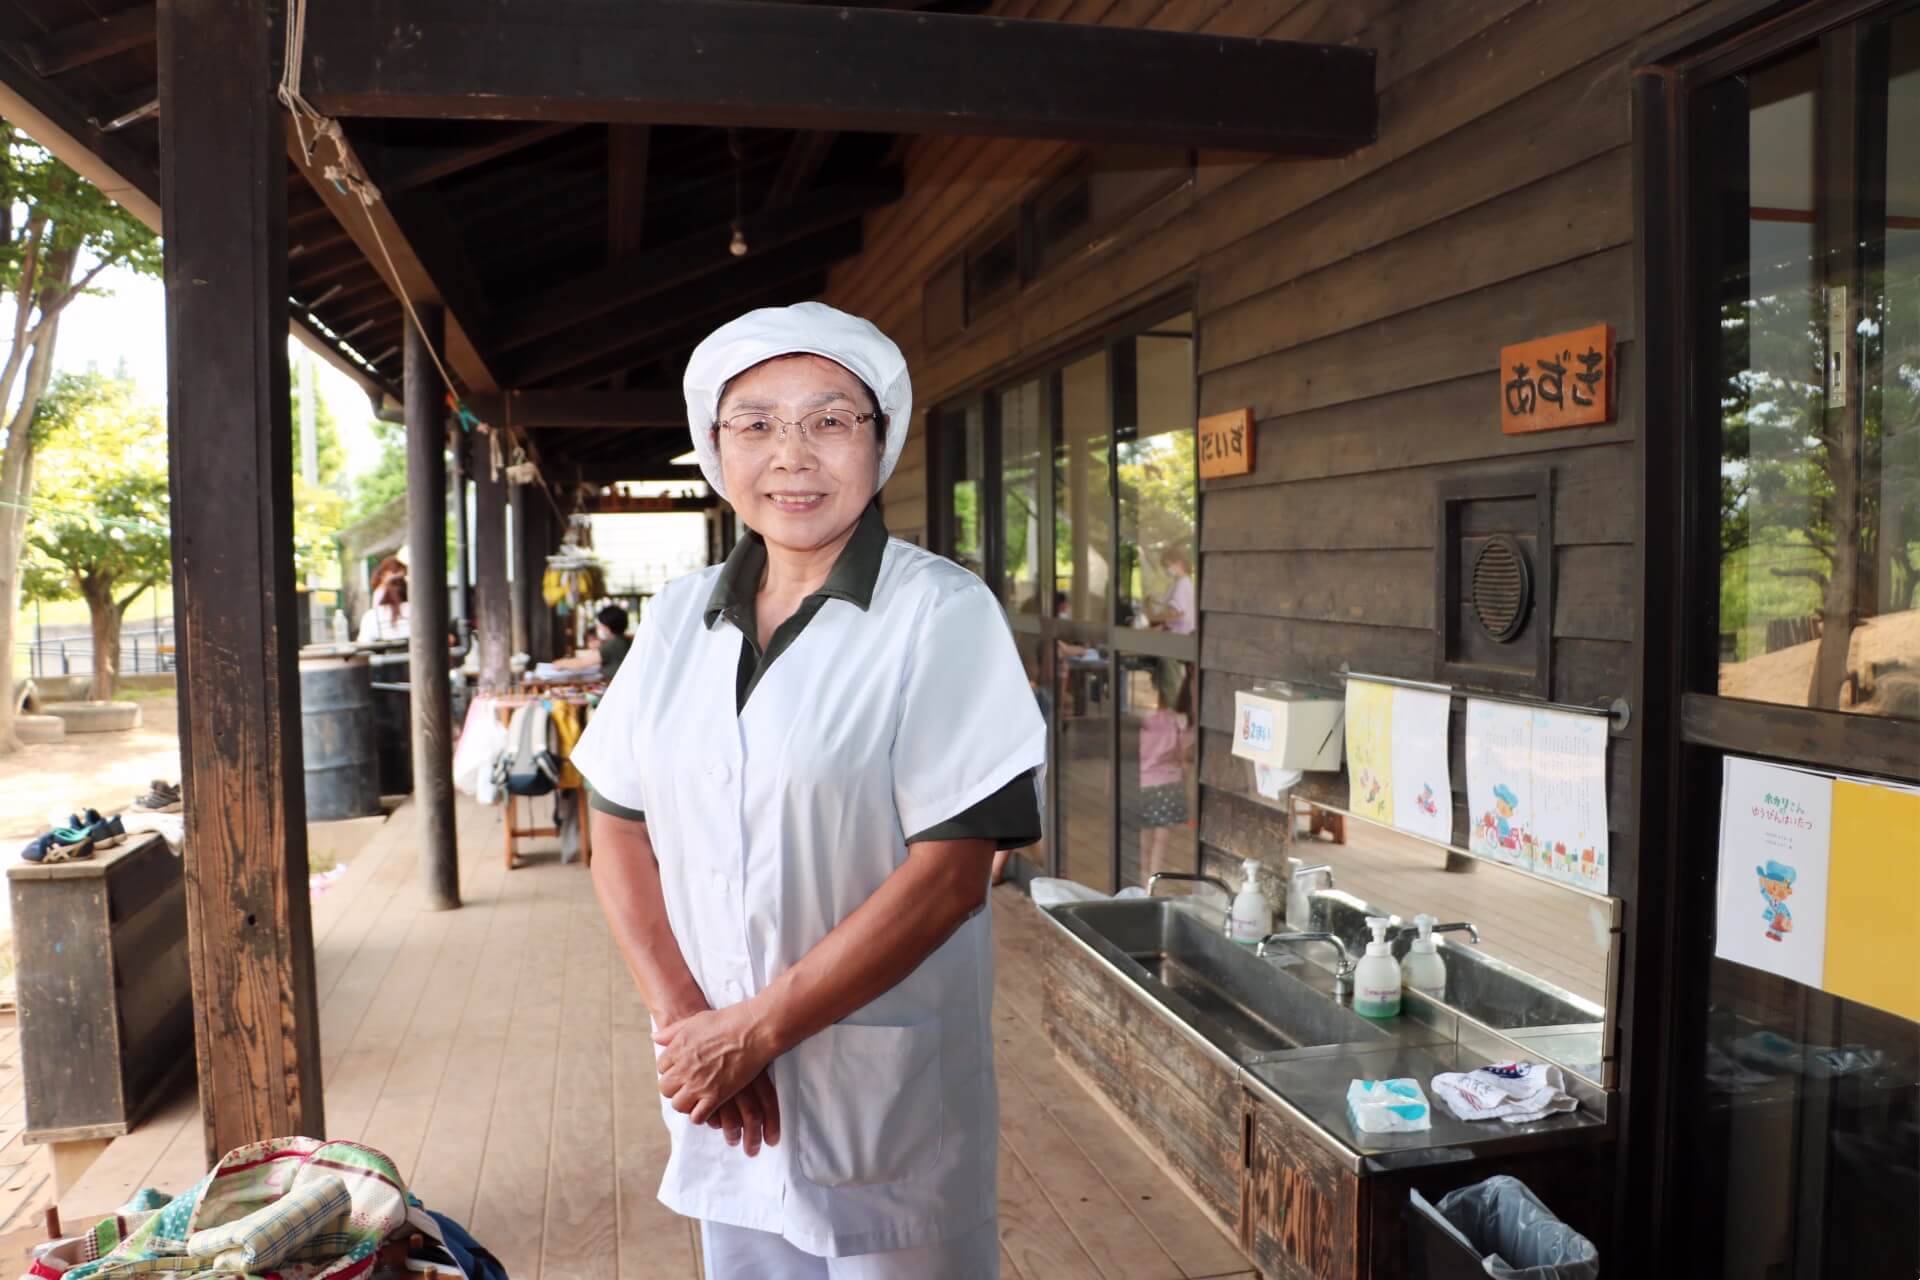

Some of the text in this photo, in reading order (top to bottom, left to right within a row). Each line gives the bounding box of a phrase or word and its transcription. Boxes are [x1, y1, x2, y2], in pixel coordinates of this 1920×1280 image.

[1506, 347, 1603, 416] あずき
[1201, 422, 1244, 464] だいず
